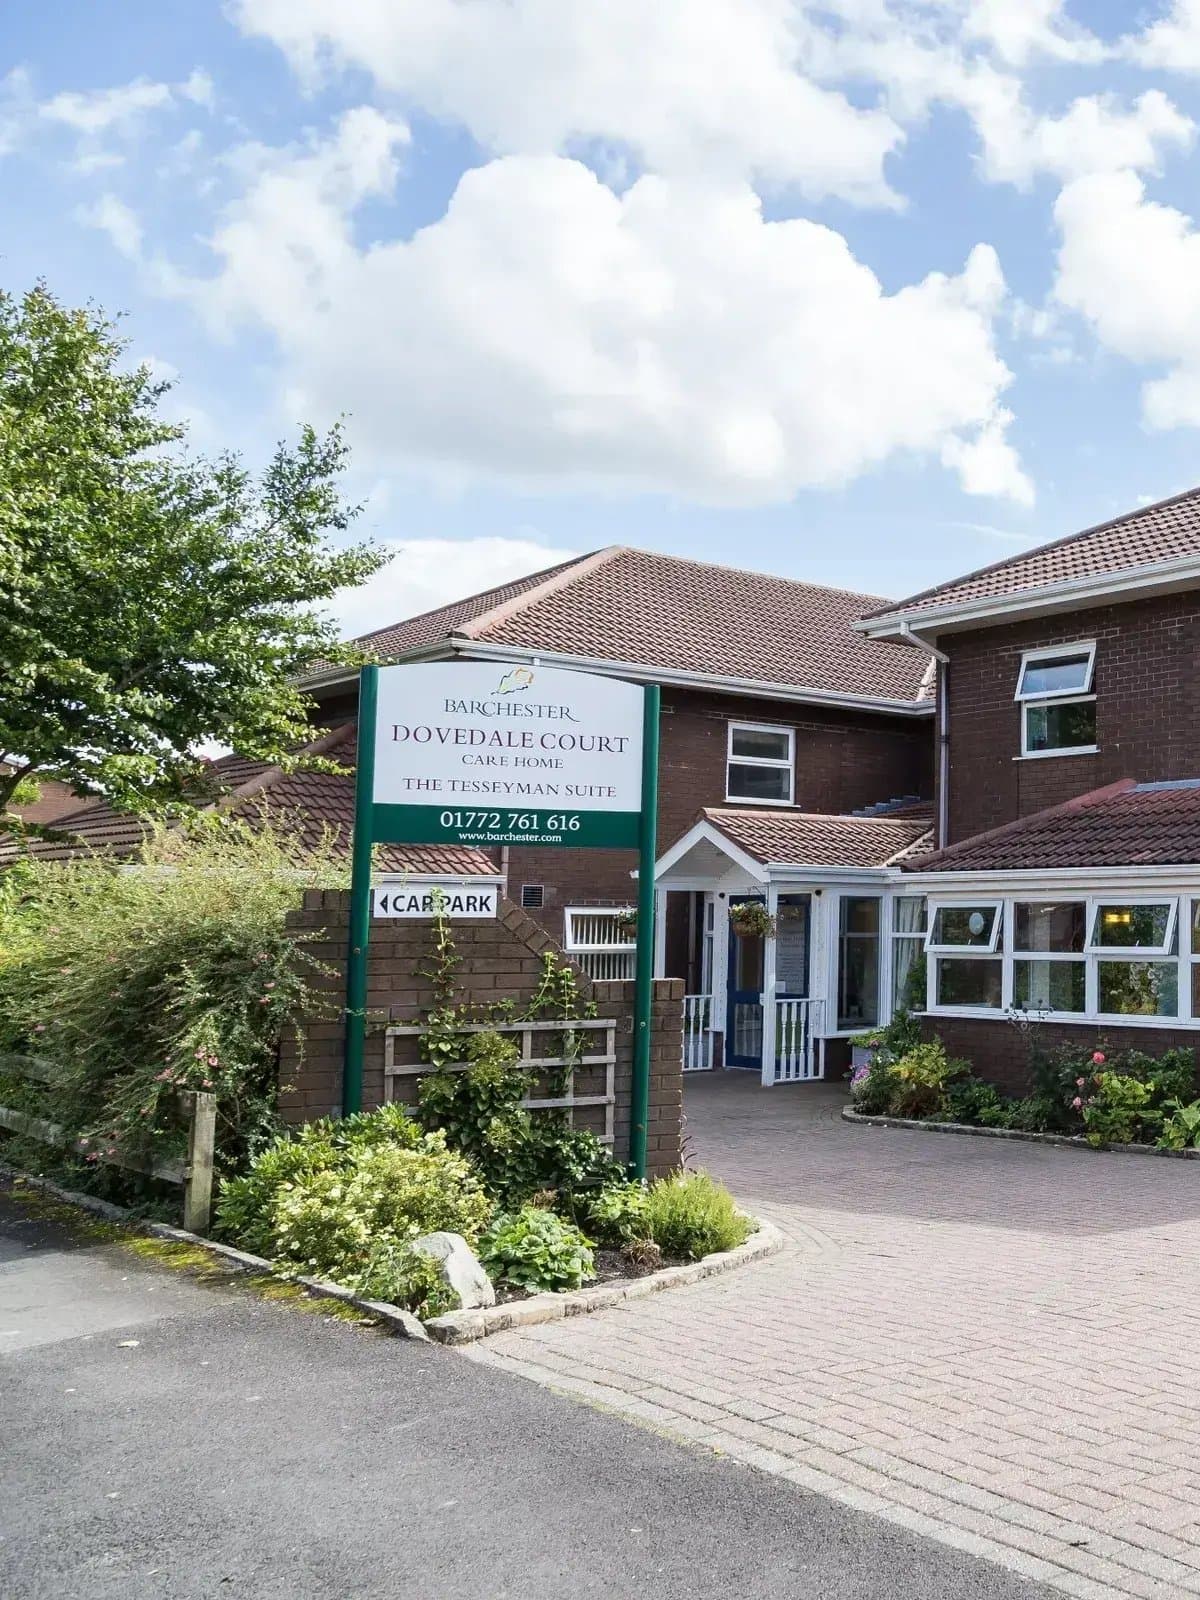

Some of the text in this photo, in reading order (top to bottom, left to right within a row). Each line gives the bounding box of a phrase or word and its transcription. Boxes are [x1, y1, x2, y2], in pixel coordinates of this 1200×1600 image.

[445, 699, 581, 722] BARCHESTER
[391, 725, 629, 753] DOVEDALE COURT
[462, 754, 564, 768] CARE HOME
[403, 778, 617, 798] THE TESSEYMAN SUITE
[440, 811, 580, 831] 01772 761 616
[458, 832, 562, 842] www.barchester.com
[392, 895, 492, 912] CAR PARK
